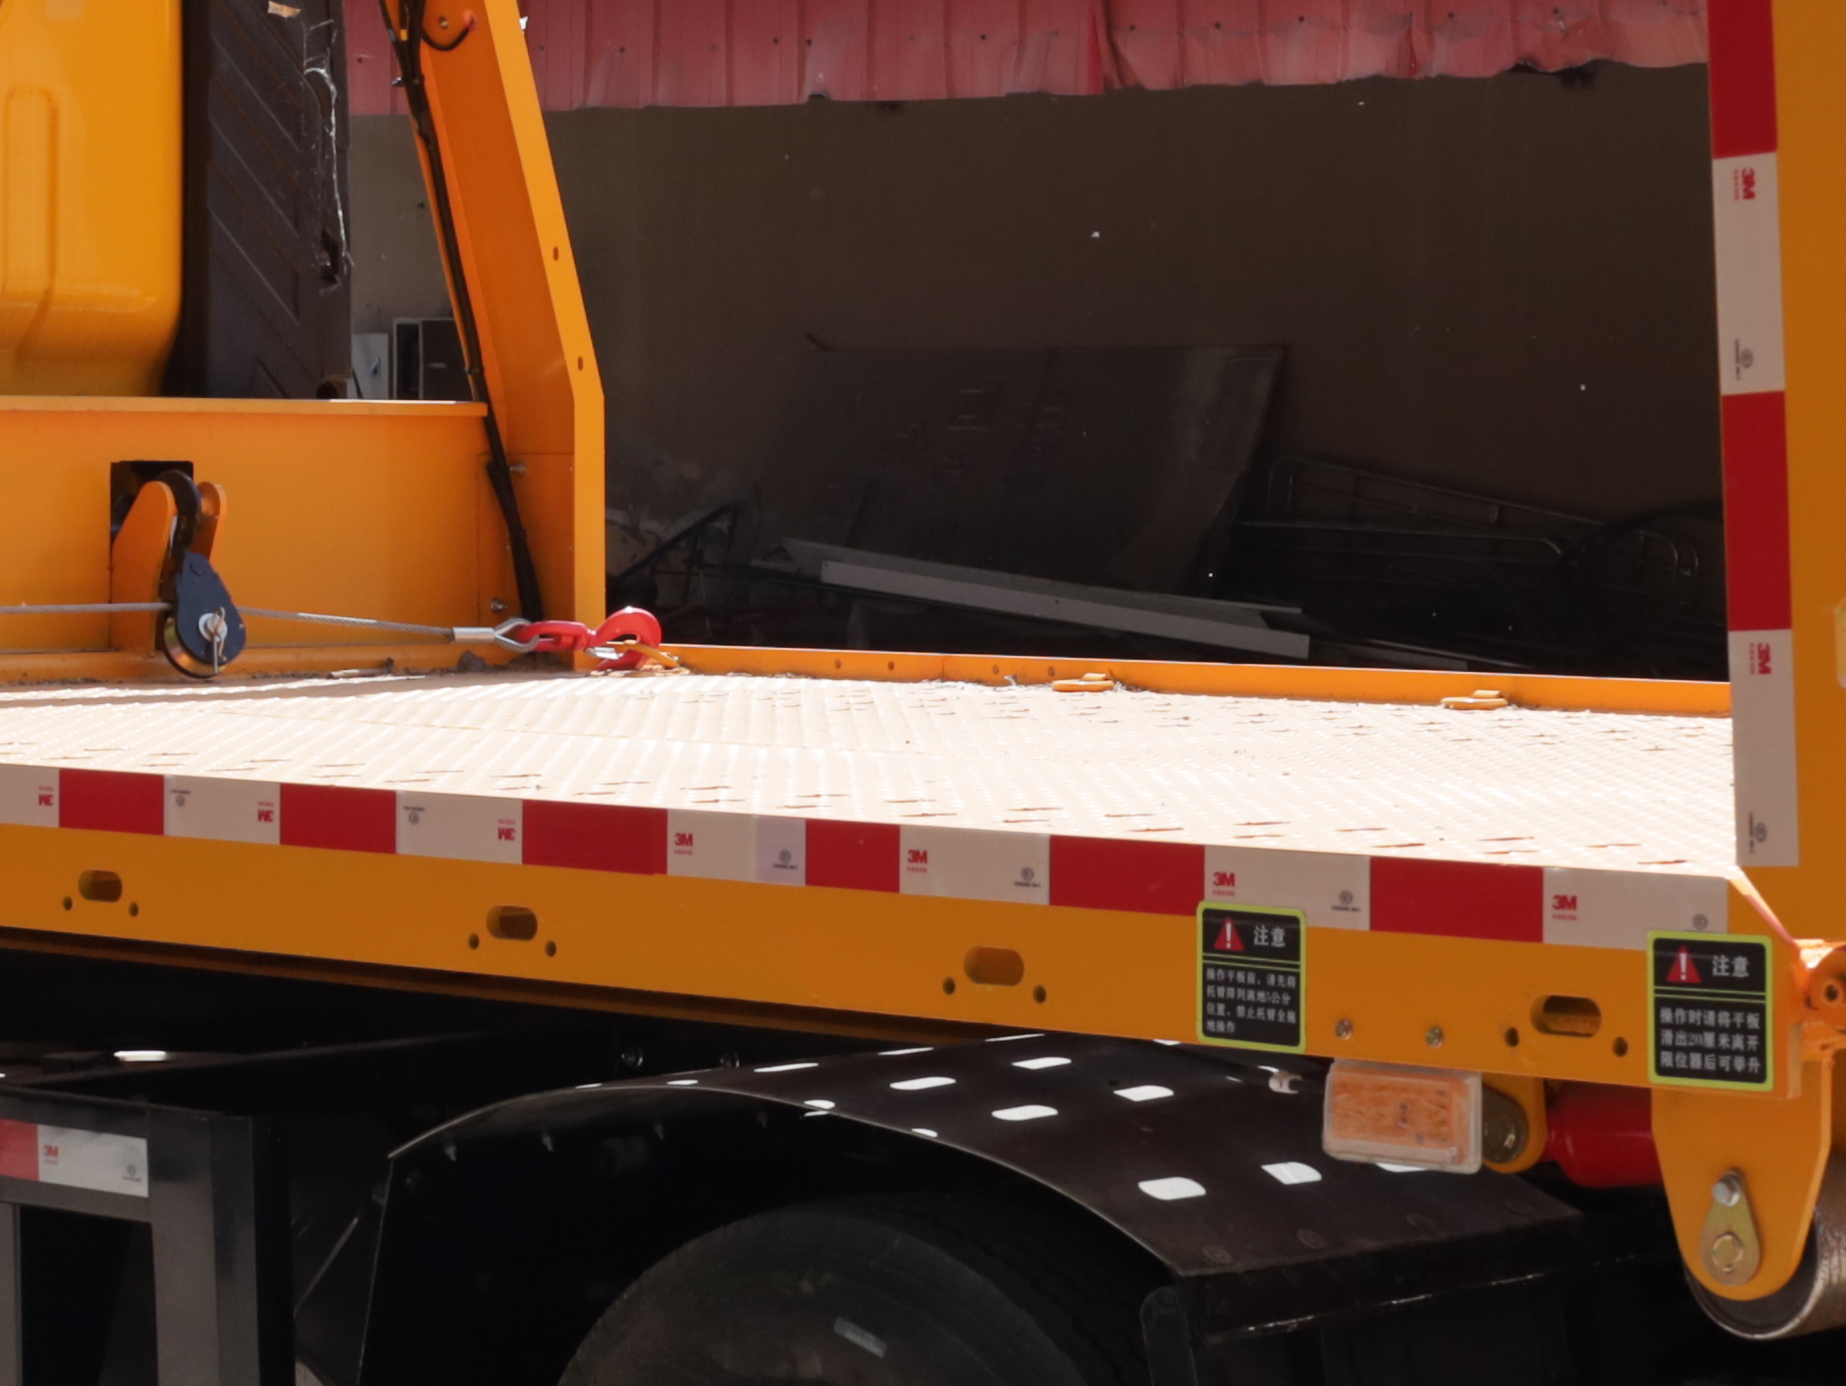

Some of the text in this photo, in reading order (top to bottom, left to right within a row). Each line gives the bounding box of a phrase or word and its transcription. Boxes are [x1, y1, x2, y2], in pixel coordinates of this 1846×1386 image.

[1741, 168, 1755, 200] 3M
[1757, 642, 1771, 675] 3M
[498, 827, 515, 841] 3M
[674, 832, 693, 847] 3M
[908, 849, 928, 864] 3M
[1213, 872, 1235, 887] 3M
[1552, 895, 1577, 910] 3M
[1253, 925, 1286, 948] 注意
[1712, 955, 1750, 979] 注意
[1660, 1007, 1760, 1030] 操作时请将平板
